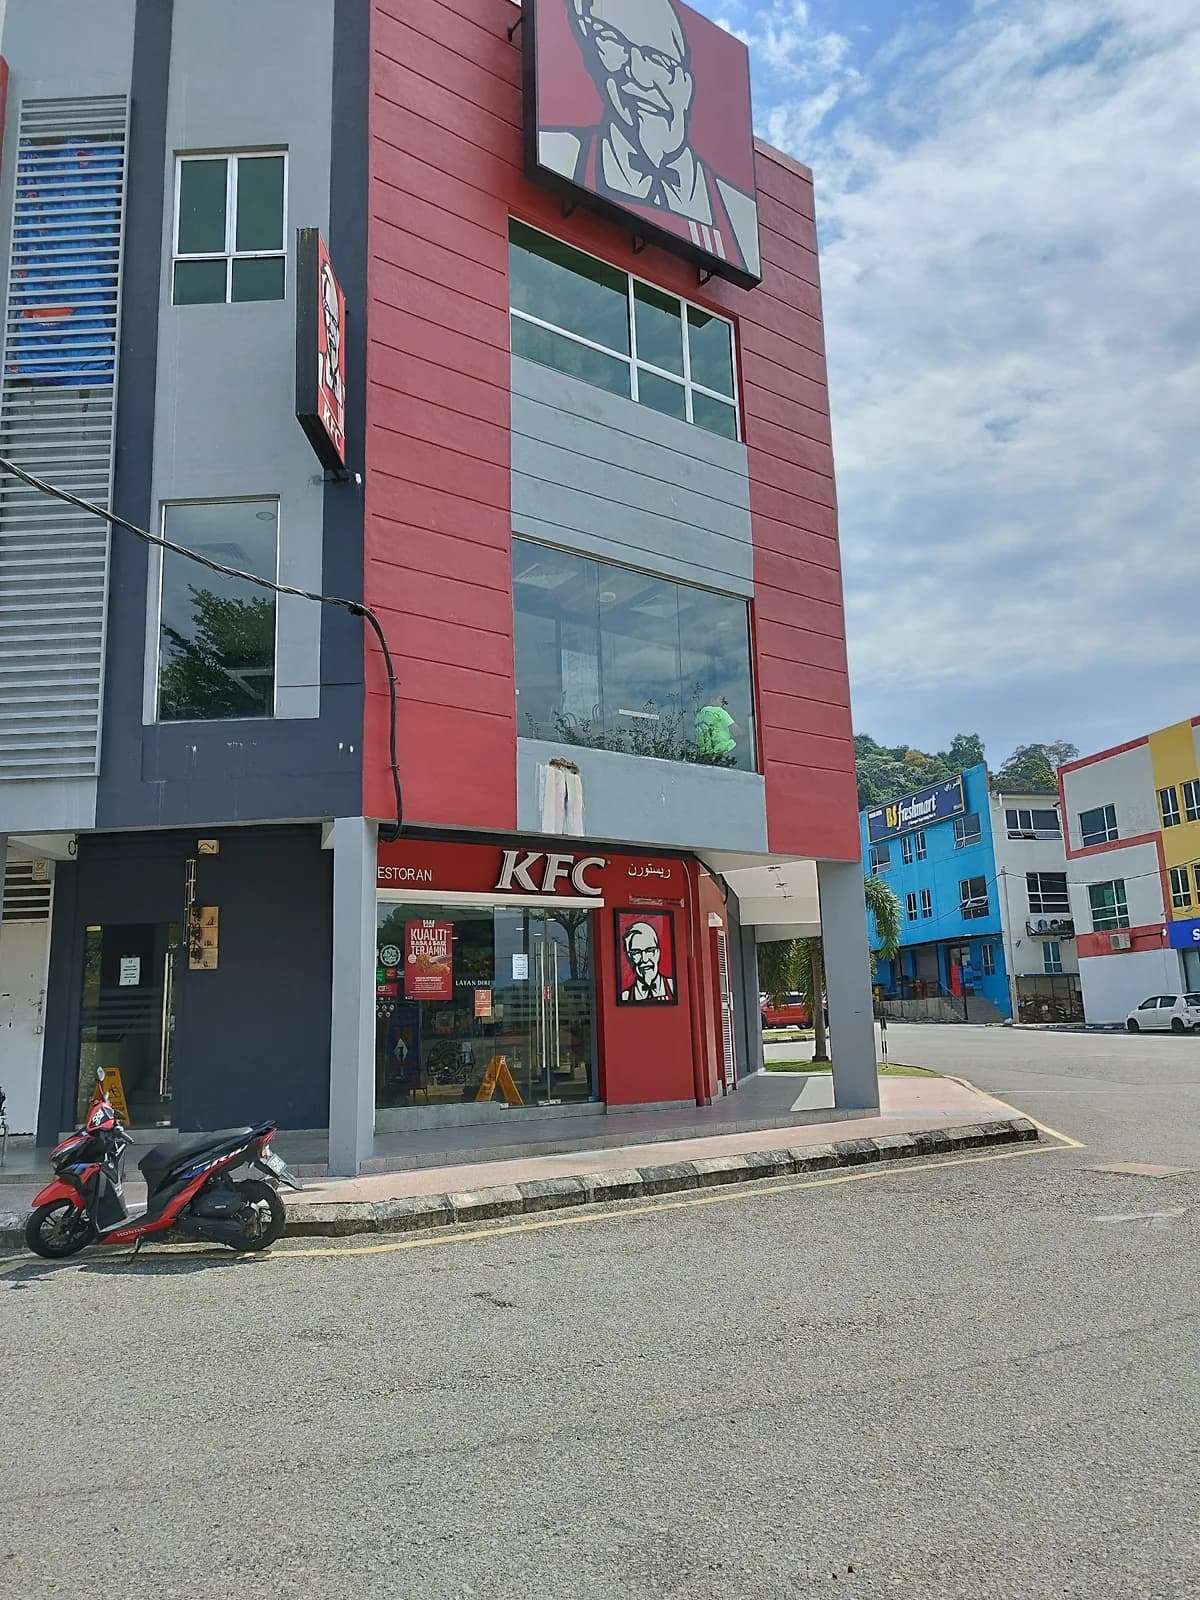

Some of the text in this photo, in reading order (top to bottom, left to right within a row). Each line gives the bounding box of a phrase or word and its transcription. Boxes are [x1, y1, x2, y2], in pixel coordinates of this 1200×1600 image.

[323, 402, 341, 451] KFC
[897, 794, 937, 831] freshmart
[377, 866, 433, 881] ESTORAN
[494, 850, 606, 895] KFC
[628, 862, 671, 879] ريستورن
[410, 928, 447, 941] KUALITI
[410, 945, 447, 956] TERJAMIN
[116, 1227, 147, 1237] HONDA
